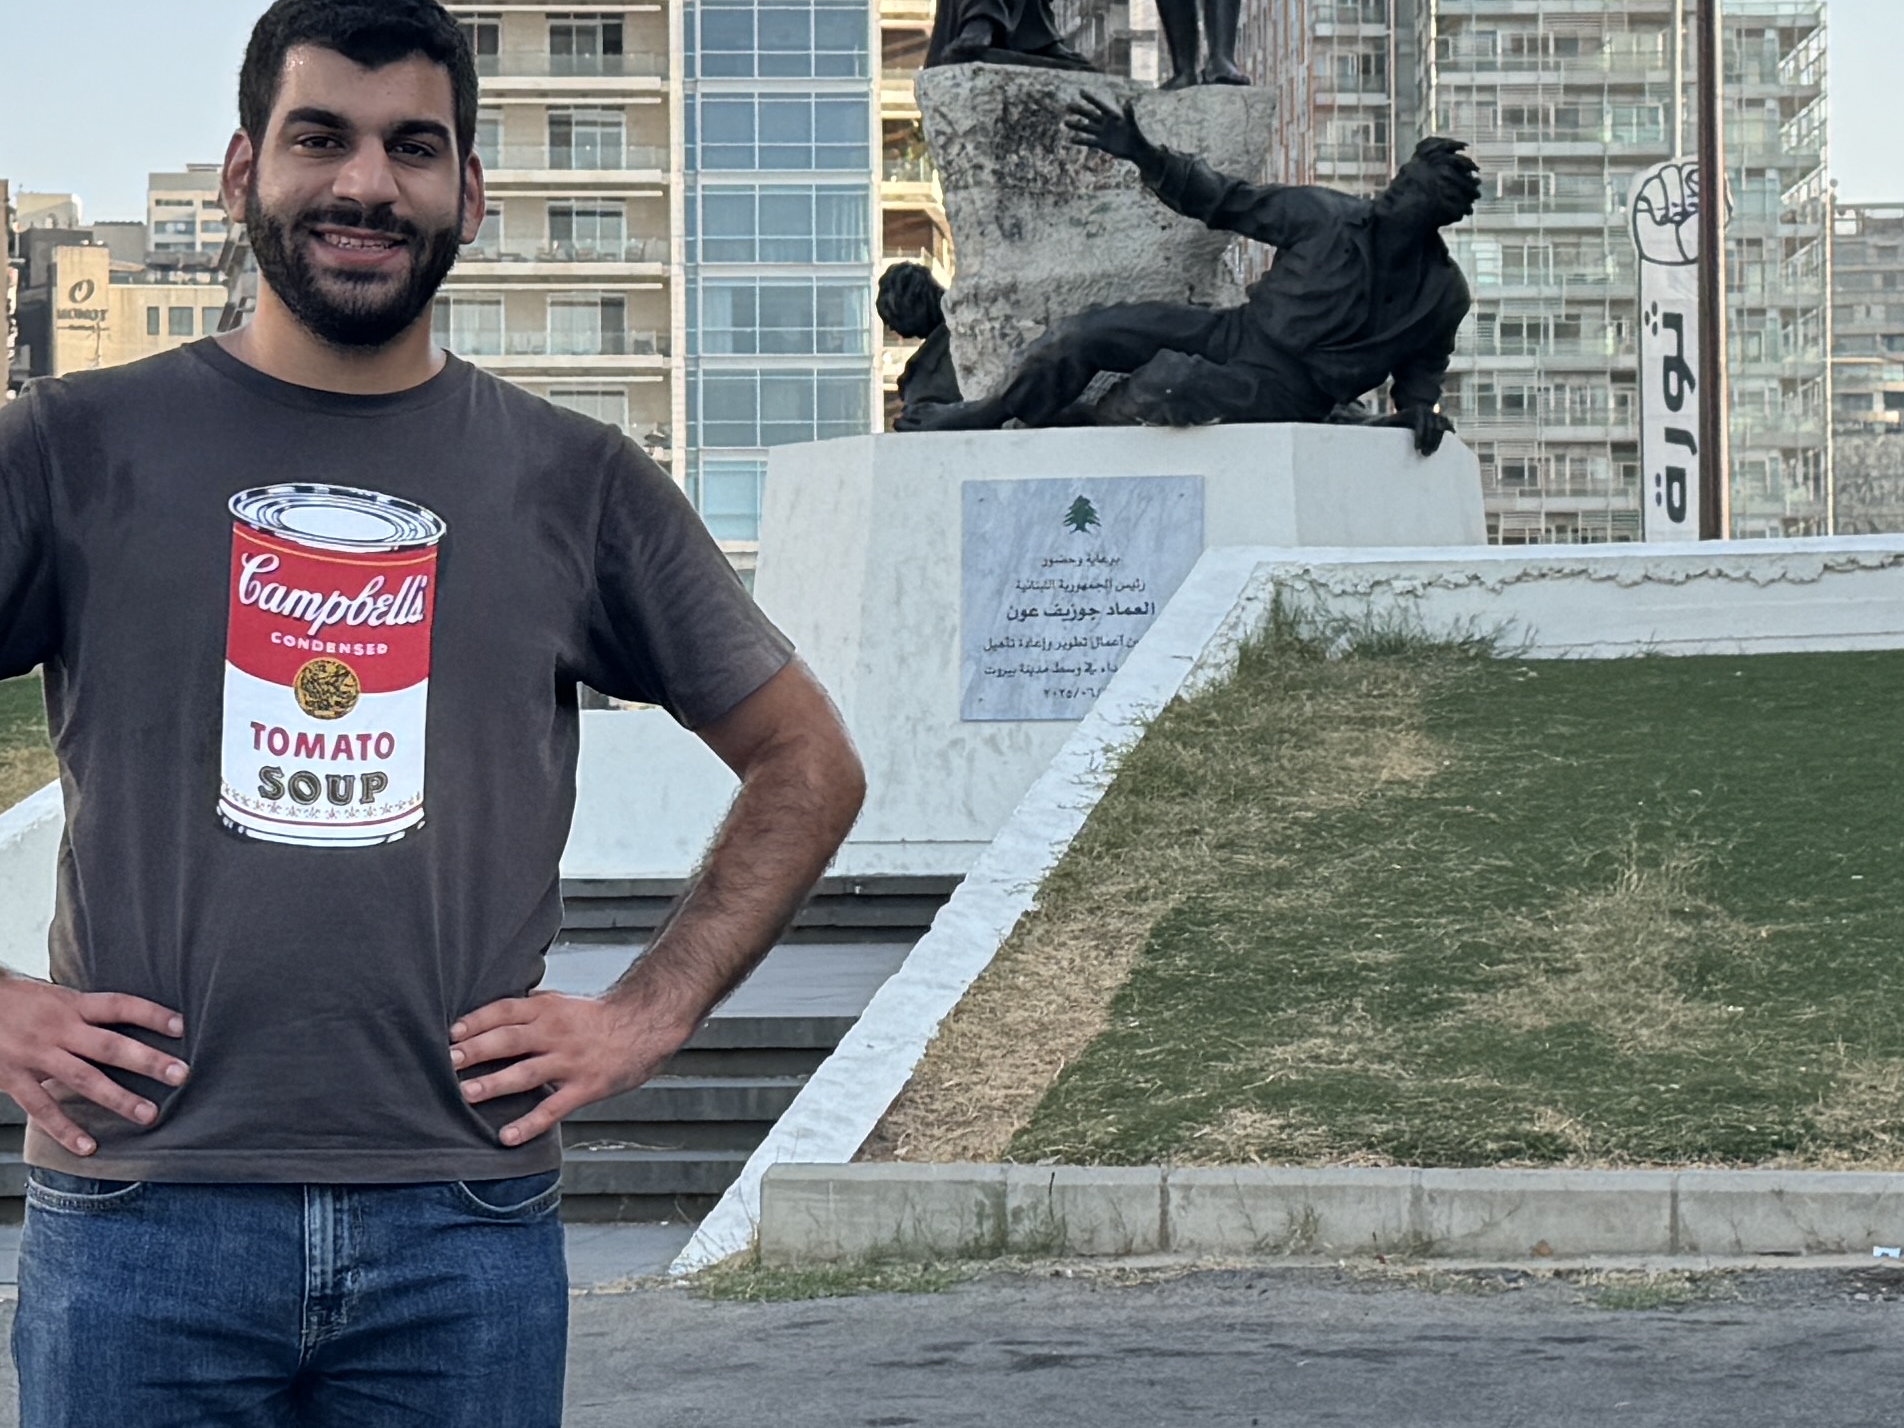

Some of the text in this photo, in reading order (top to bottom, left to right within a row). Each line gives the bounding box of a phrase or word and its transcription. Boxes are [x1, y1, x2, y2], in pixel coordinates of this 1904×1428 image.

[1644, 300, 1698, 524] ثورة
[238, 552, 428, 636] Campbell's
[1114, 578, 1146, 592] رئيس
[1006, 601, 1156, 622] العماد جوزيف عون
[270, 631, 389, 656] CONDENSED
[983, 664, 1017, 678] بيروت
[250, 721, 395, 761] TOMATO
[257, 765, 388, 806] SOUP
